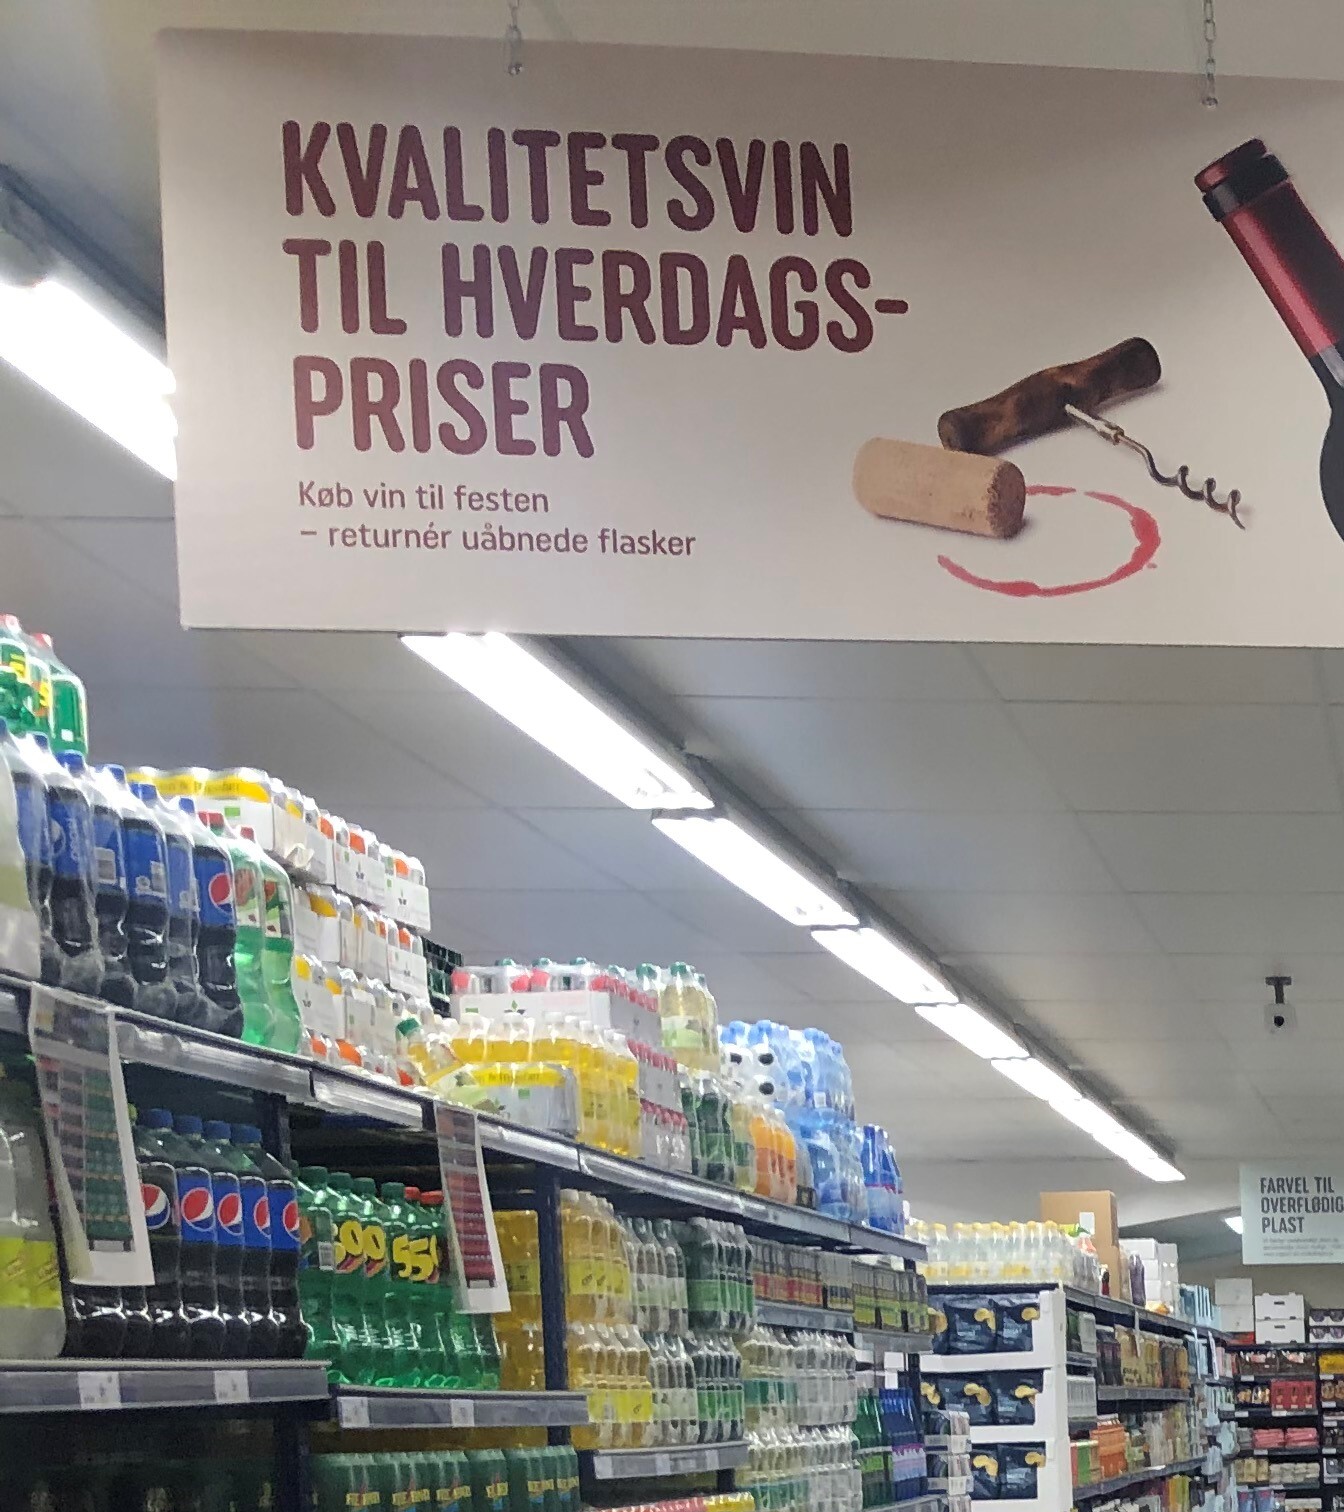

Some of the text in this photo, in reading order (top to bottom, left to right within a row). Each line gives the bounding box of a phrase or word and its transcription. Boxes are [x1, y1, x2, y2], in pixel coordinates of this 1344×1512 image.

[282, 120, 853, 238] KVALITETSVIN
[282, 238, 909, 354] TIL HVERDAGS-
[293, 354, 595, 459] PRISER
[298, 480, 550, 514] Køb vin til festen
[328, 521, 452, 550] returnér
[462, 523, 589, 556] uåbnede
[599, 527, 697, 556] flasker
[1260, 1176, 1335, 1195] FARVEL TIL
[1261, 1195, 1344, 1214] OVERFLØDIG
[1261, 1216, 1305, 1234] PLAST
